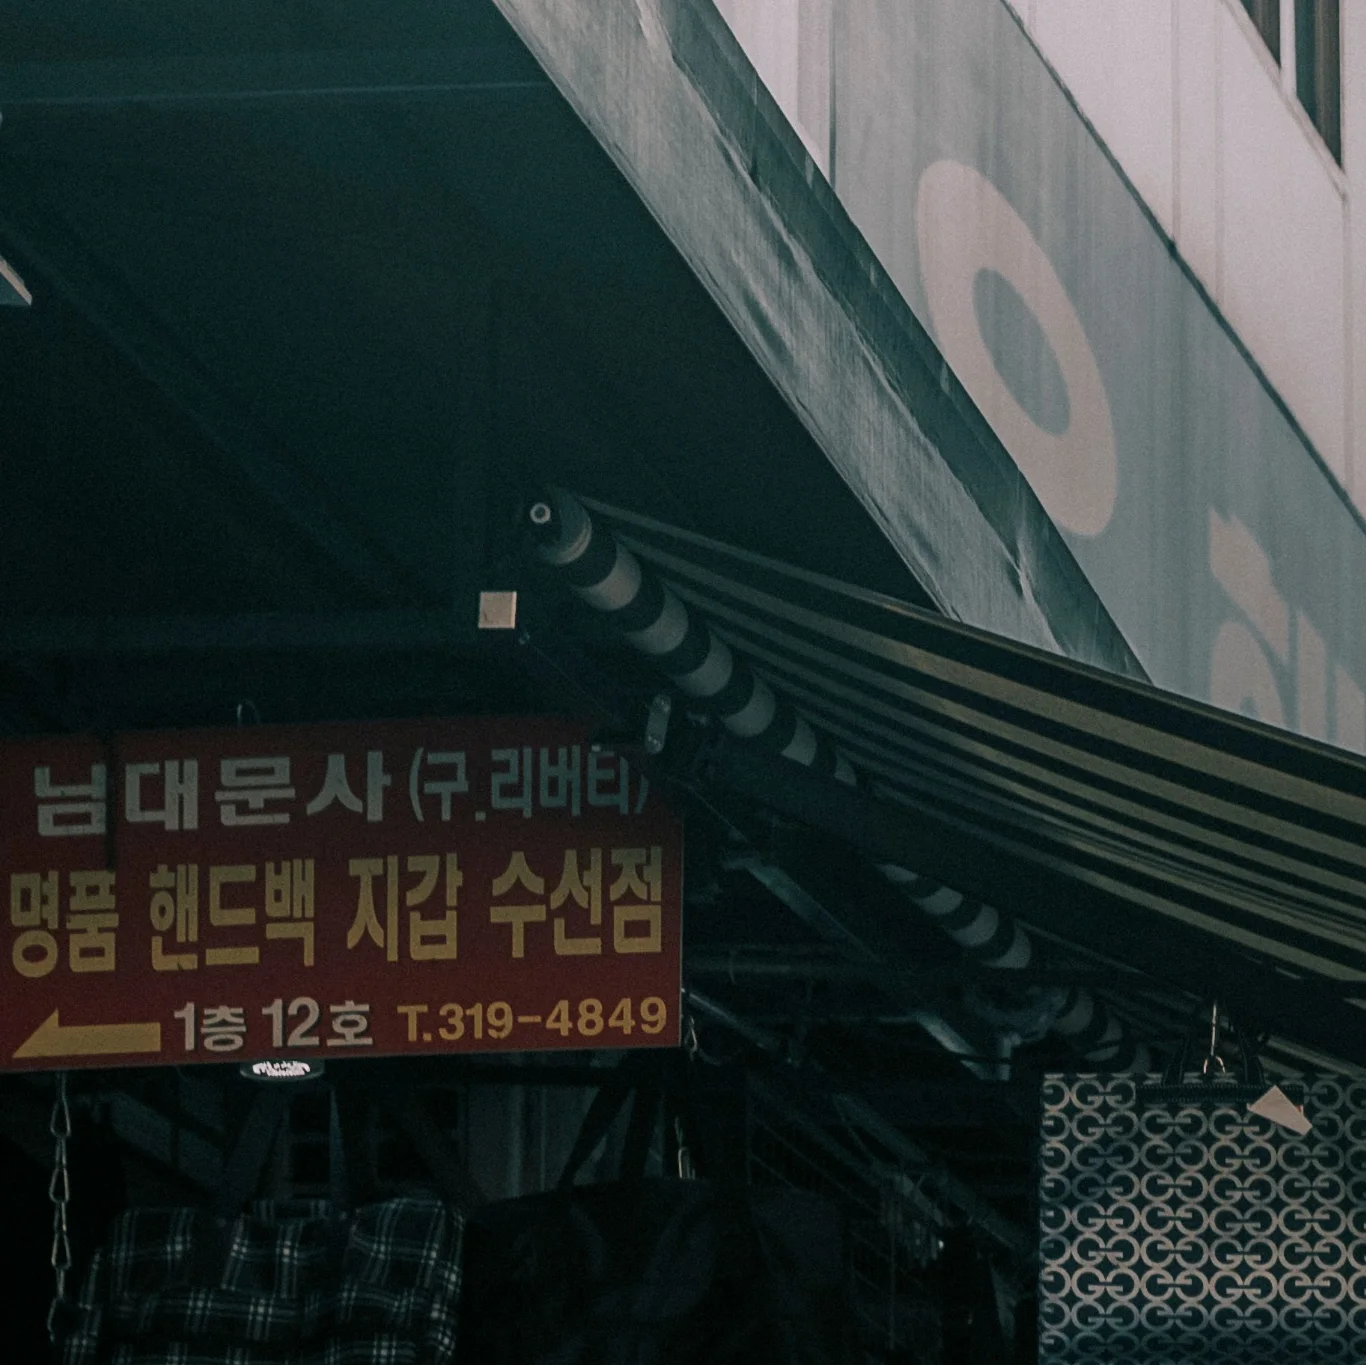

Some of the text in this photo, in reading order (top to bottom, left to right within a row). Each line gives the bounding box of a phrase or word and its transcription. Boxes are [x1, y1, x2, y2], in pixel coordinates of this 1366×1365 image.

[10, 845, 662, 978] 명품 핸드백 지갑 수선점
[174, 995, 668, 1053] 1층 12호 T.319-4849
